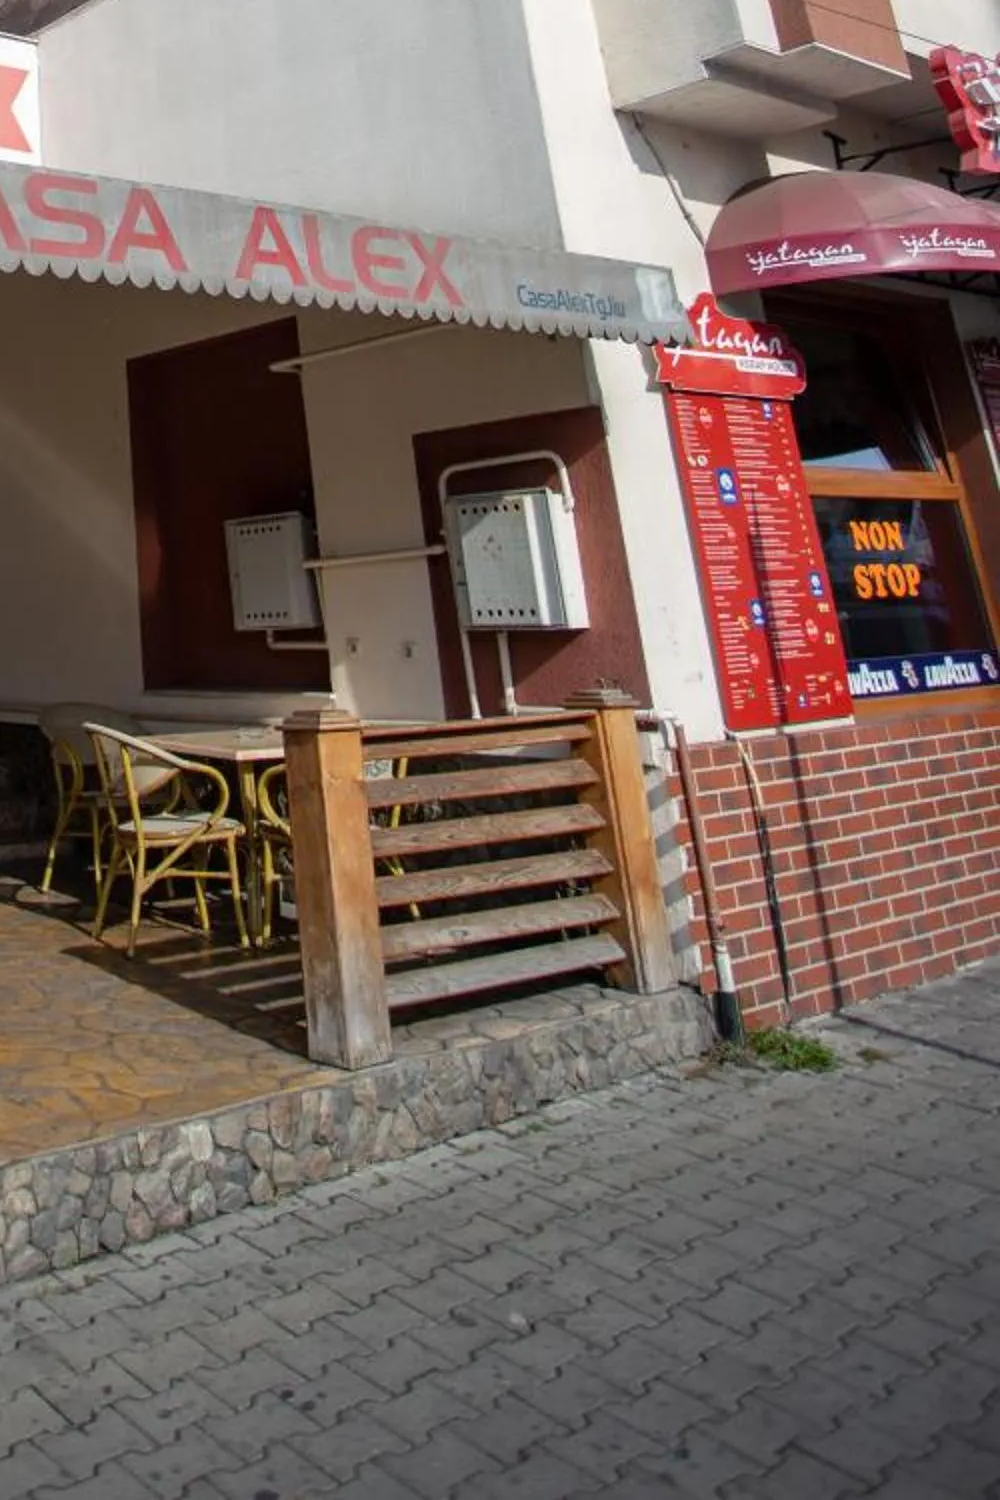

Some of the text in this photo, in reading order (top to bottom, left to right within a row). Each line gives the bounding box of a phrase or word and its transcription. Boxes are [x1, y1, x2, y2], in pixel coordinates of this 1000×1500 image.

[234, 205, 466, 307] ALEX
[672, 306, 782, 367] tagan
[850, 520, 904, 551] NON
[854, 563, 920, 599] STOP
[924, 655, 981, 688] LAVAZZA
